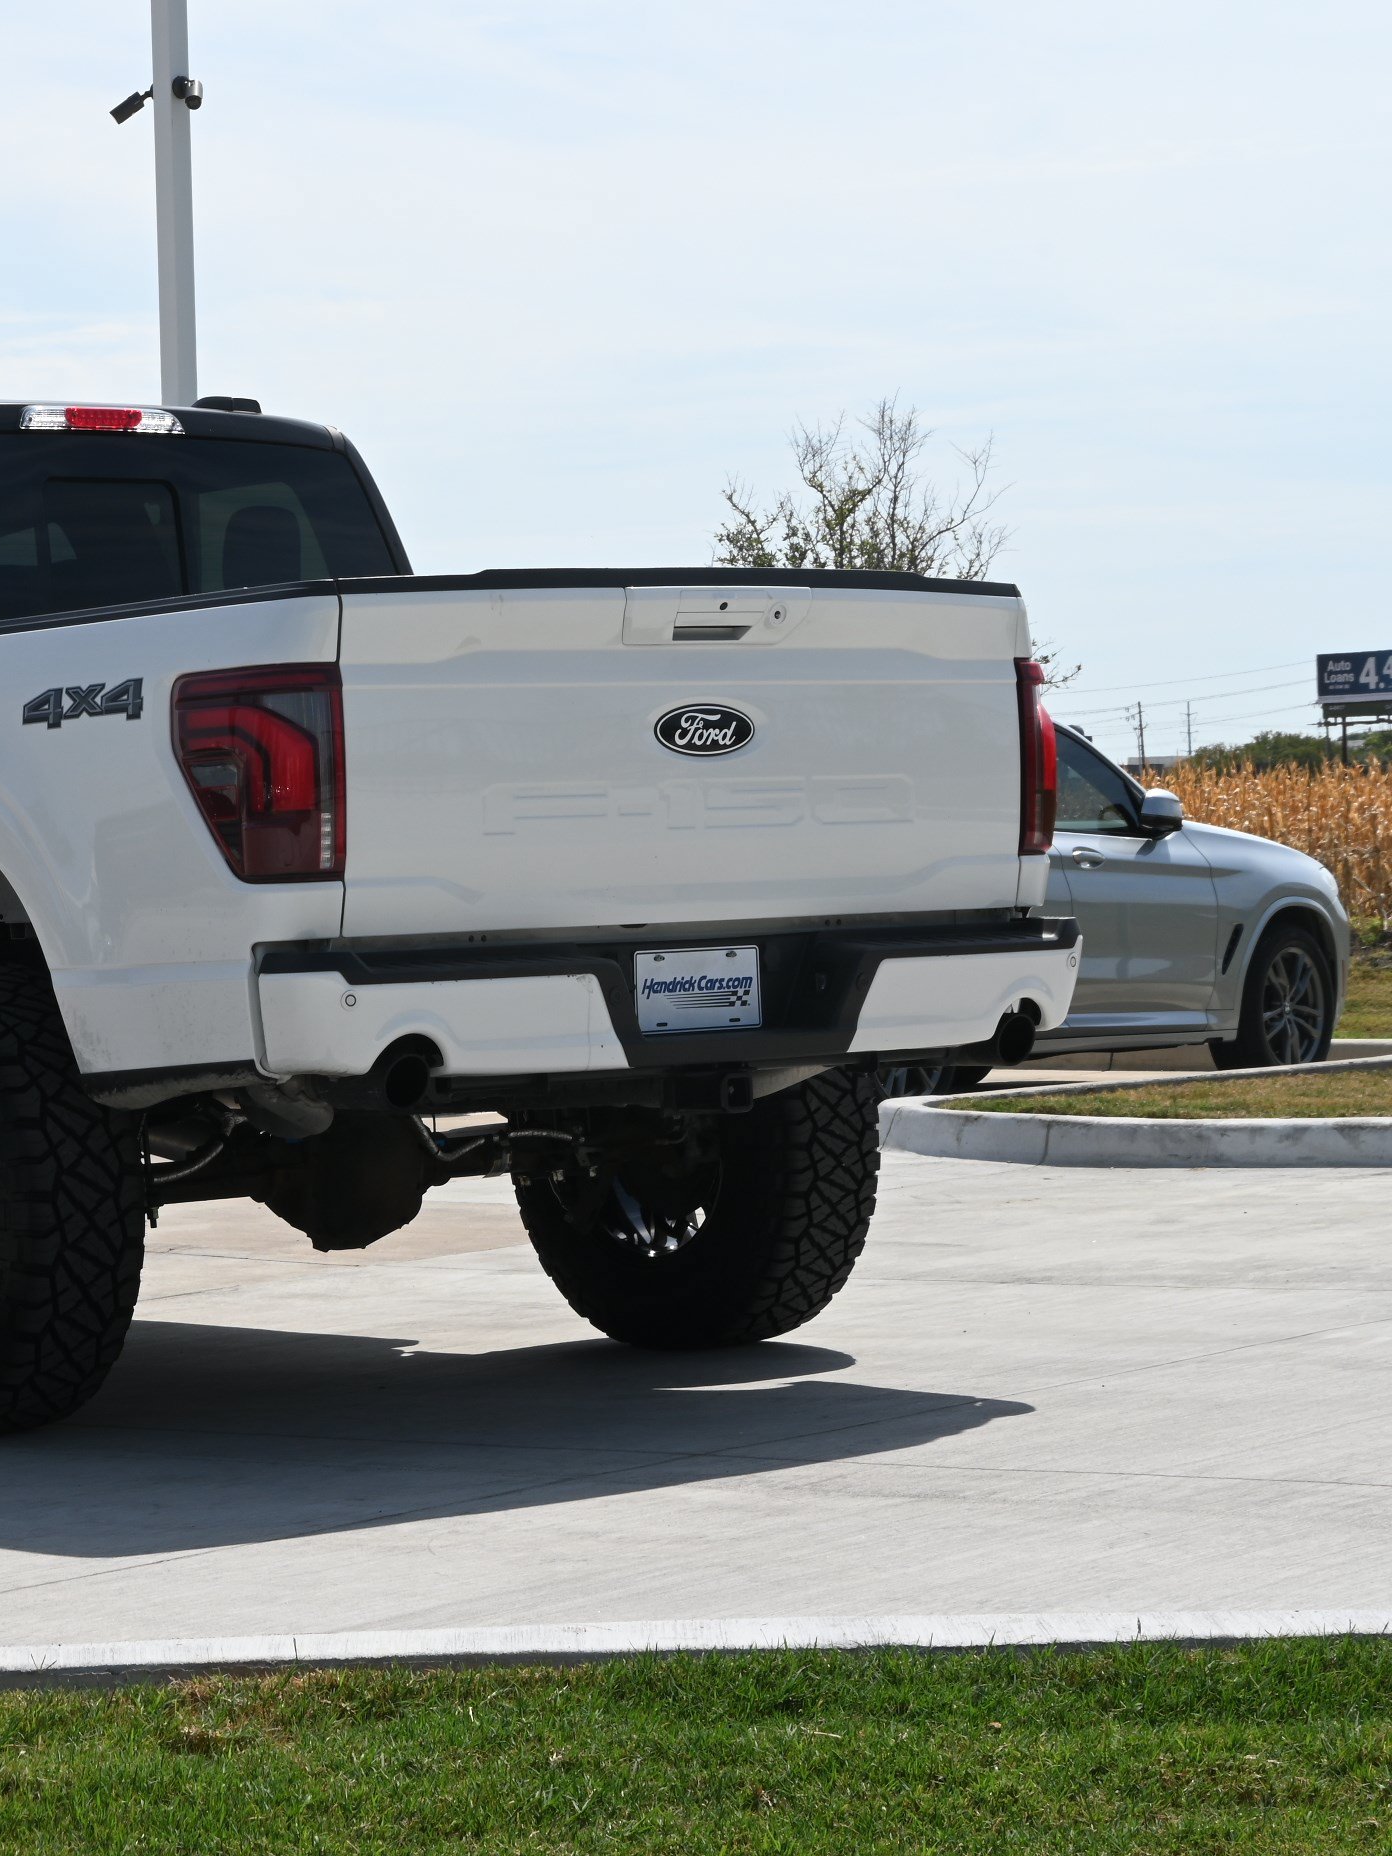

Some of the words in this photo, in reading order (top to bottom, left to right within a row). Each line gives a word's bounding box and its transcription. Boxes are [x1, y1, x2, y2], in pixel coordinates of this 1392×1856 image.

[1327, 660, 1352, 671] Auto
[1324, 672, 1355, 683] Loans
[674, 712, 737, 746] Ford
